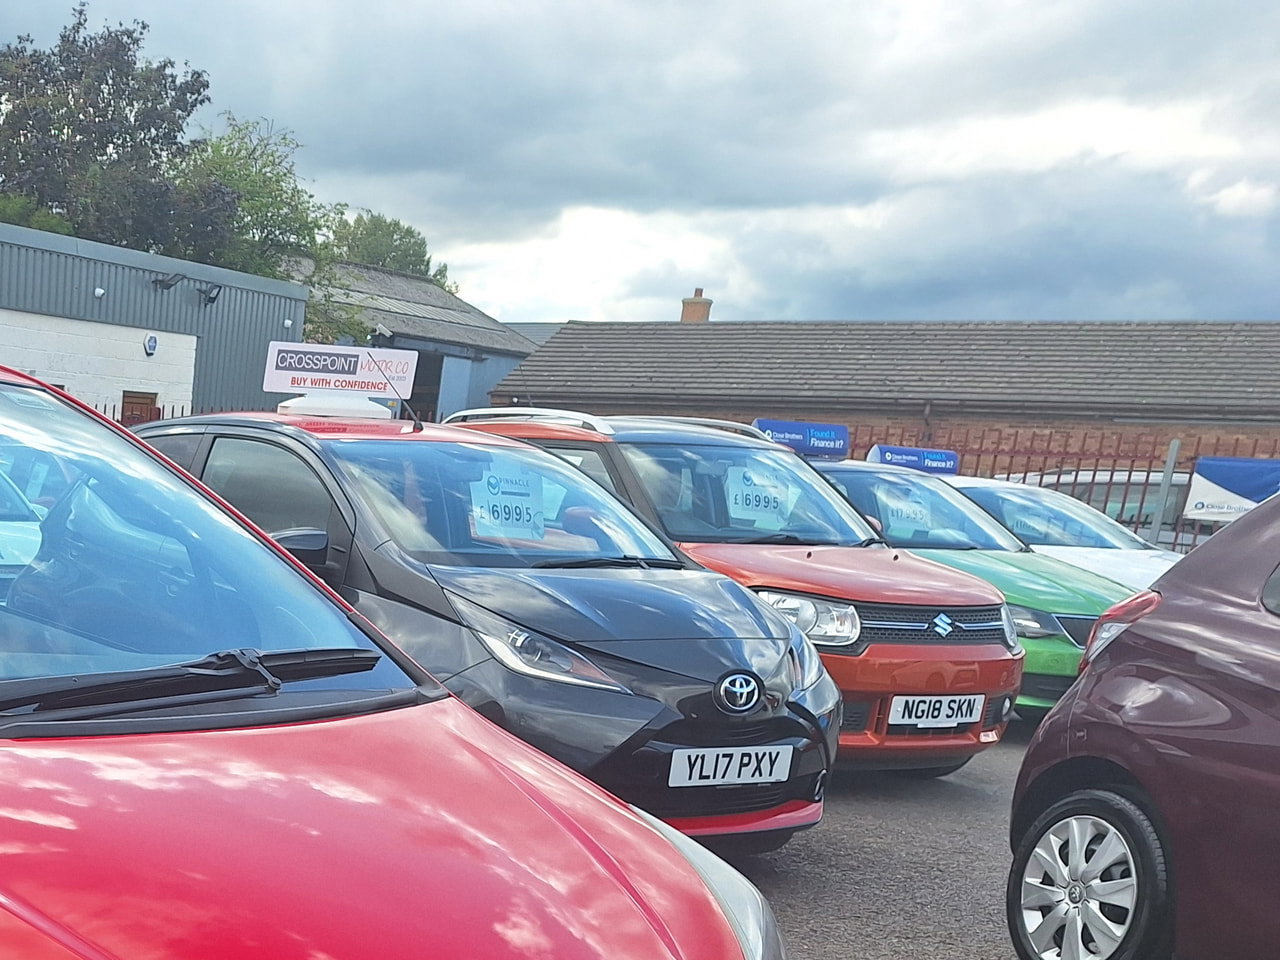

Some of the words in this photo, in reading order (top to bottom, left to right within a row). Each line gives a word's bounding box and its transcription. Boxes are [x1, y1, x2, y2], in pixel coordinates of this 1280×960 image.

[276, 352, 357, 372] CROSSPOINT
[395, 360, 409, 374] CO
[290, 376, 308, 386] BUY
[310, 378, 331, 388] WITH
[333, 379, 388, 391] CONFIDENCE
[810, 428, 830, 438] Found
[810, 437, 834, 448] Finance
[924, 458, 946, 468] Finance
[901, 699, 943, 720] NG18
[945, 698, 977, 719] SKN
[687, 752, 734, 781] YL17
[737, 750, 781, 779] PXY
